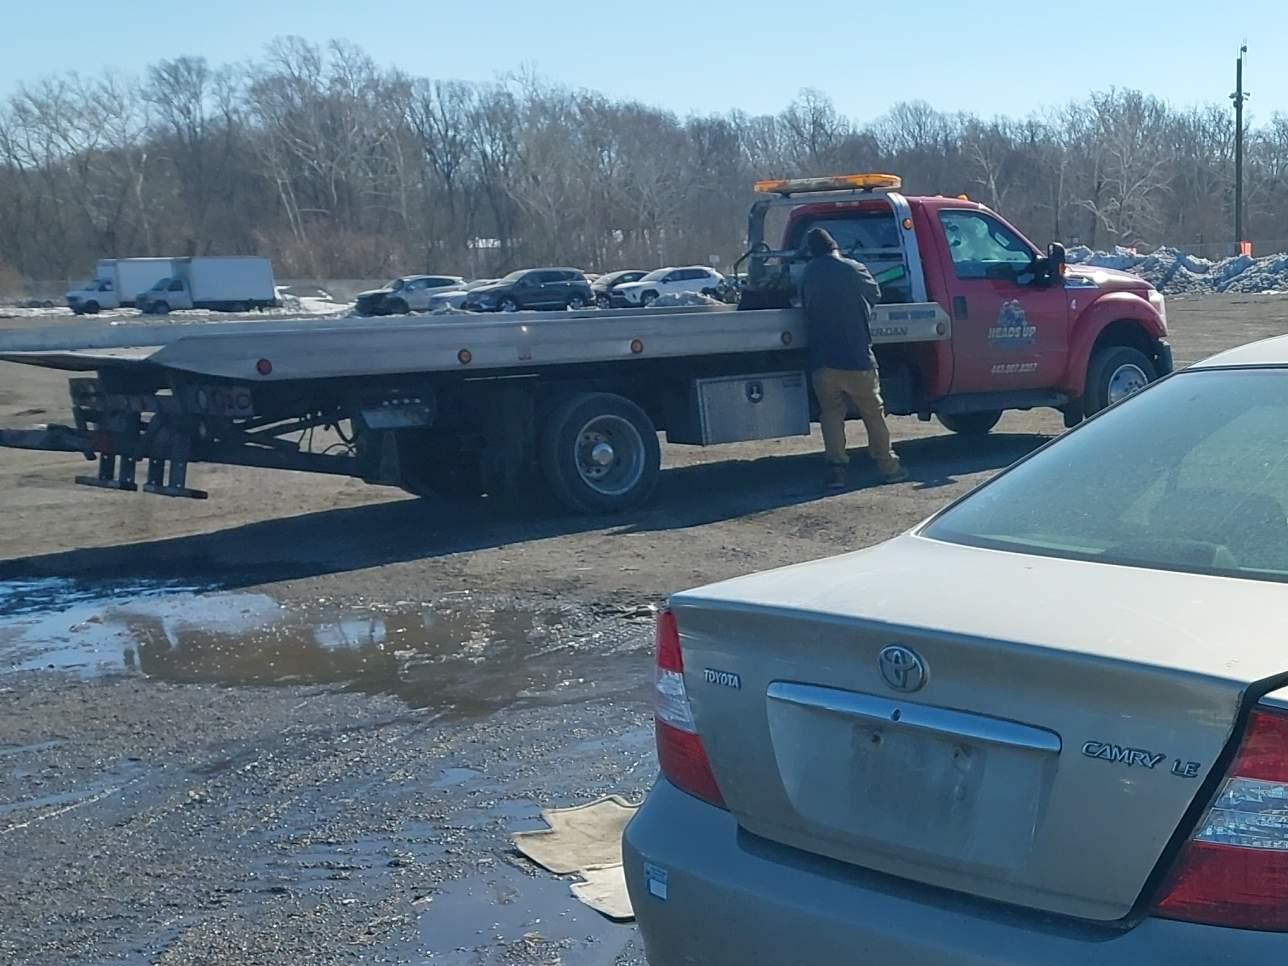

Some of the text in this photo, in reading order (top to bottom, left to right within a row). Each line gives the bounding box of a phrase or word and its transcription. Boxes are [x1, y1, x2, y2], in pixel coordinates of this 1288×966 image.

[988, 326, 1037, 339] HEADS UP
[704, 667, 741, 690] TOYOTA
[1081, 741, 1200, 778] CAMRY LE
